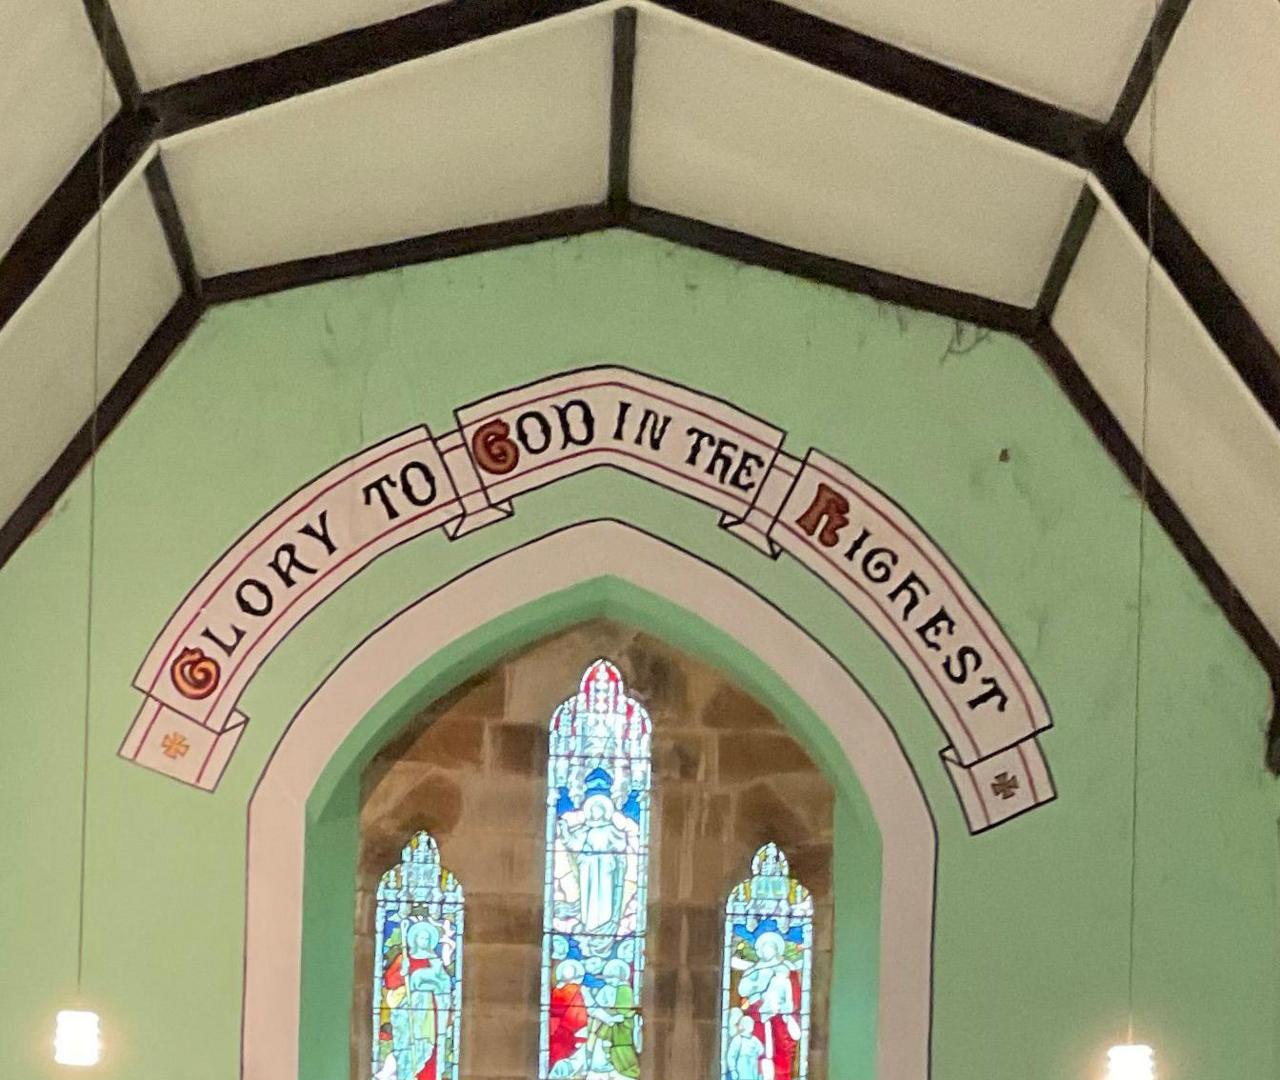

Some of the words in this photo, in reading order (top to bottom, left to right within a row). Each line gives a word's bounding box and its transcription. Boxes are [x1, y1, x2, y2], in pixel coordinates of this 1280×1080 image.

[170, 509, 338, 700] GLORY
[362, 461, 437, 520] TO
[472, 399, 595, 475] GOD
[613, 401, 672, 450] IN
[685, 427, 765, 492] THE
[795, 482, 1009, 712] HIGHEST
